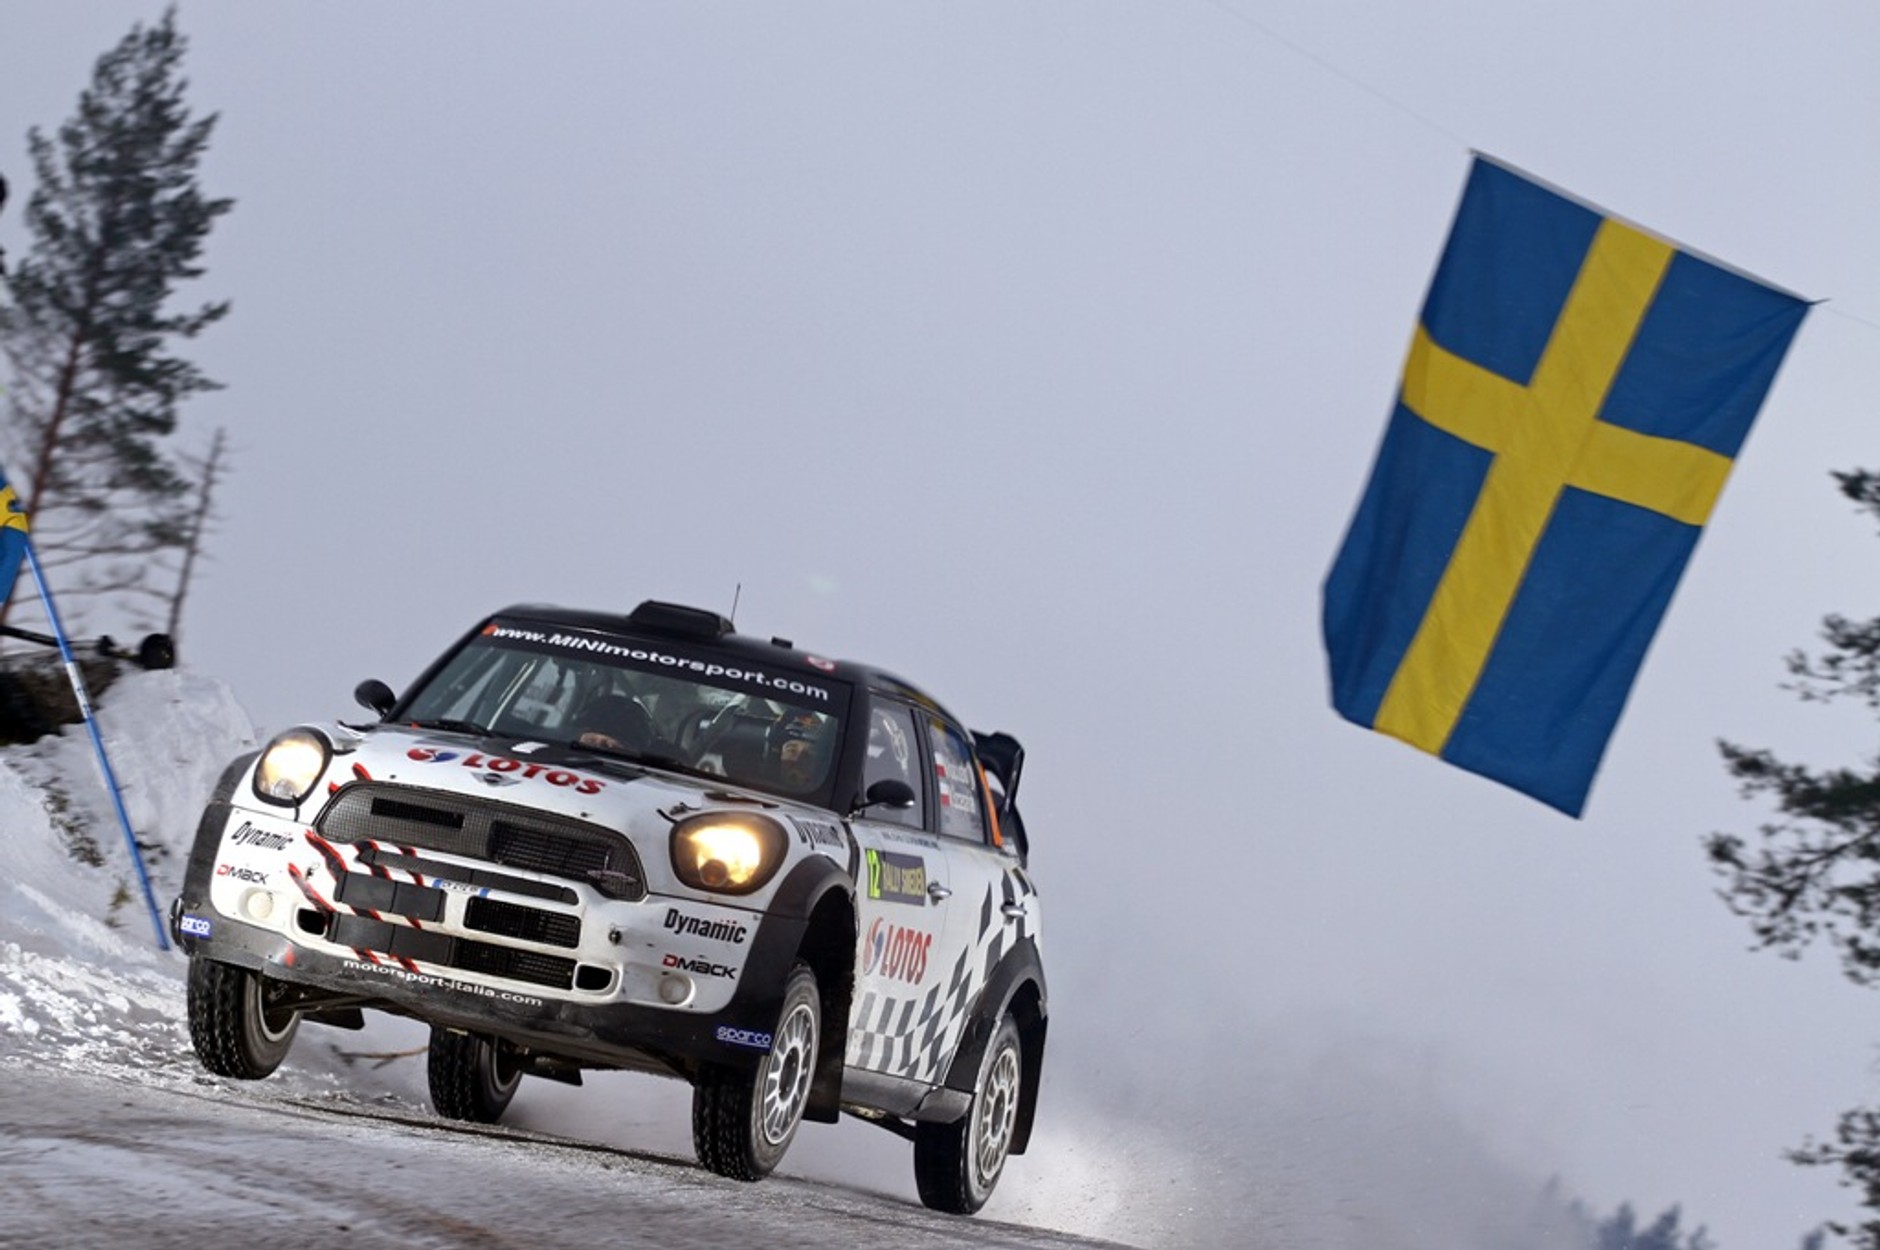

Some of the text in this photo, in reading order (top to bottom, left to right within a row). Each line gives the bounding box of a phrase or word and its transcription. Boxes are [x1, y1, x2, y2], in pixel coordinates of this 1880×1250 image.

[493, 626, 829, 701] www.MINImotorsport.com
[462, 754, 606, 795] LOTOS
[231, 820, 294, 851] Dynamic
[866, 848, 881, 898] 12
[664, 908, 747, 944] Dynamic
[880, 924, 932, 985] LOTOS
[343, 959, 543, 1007] motorsport-italia.com
[717, 1026, 772, 1047] sparco
